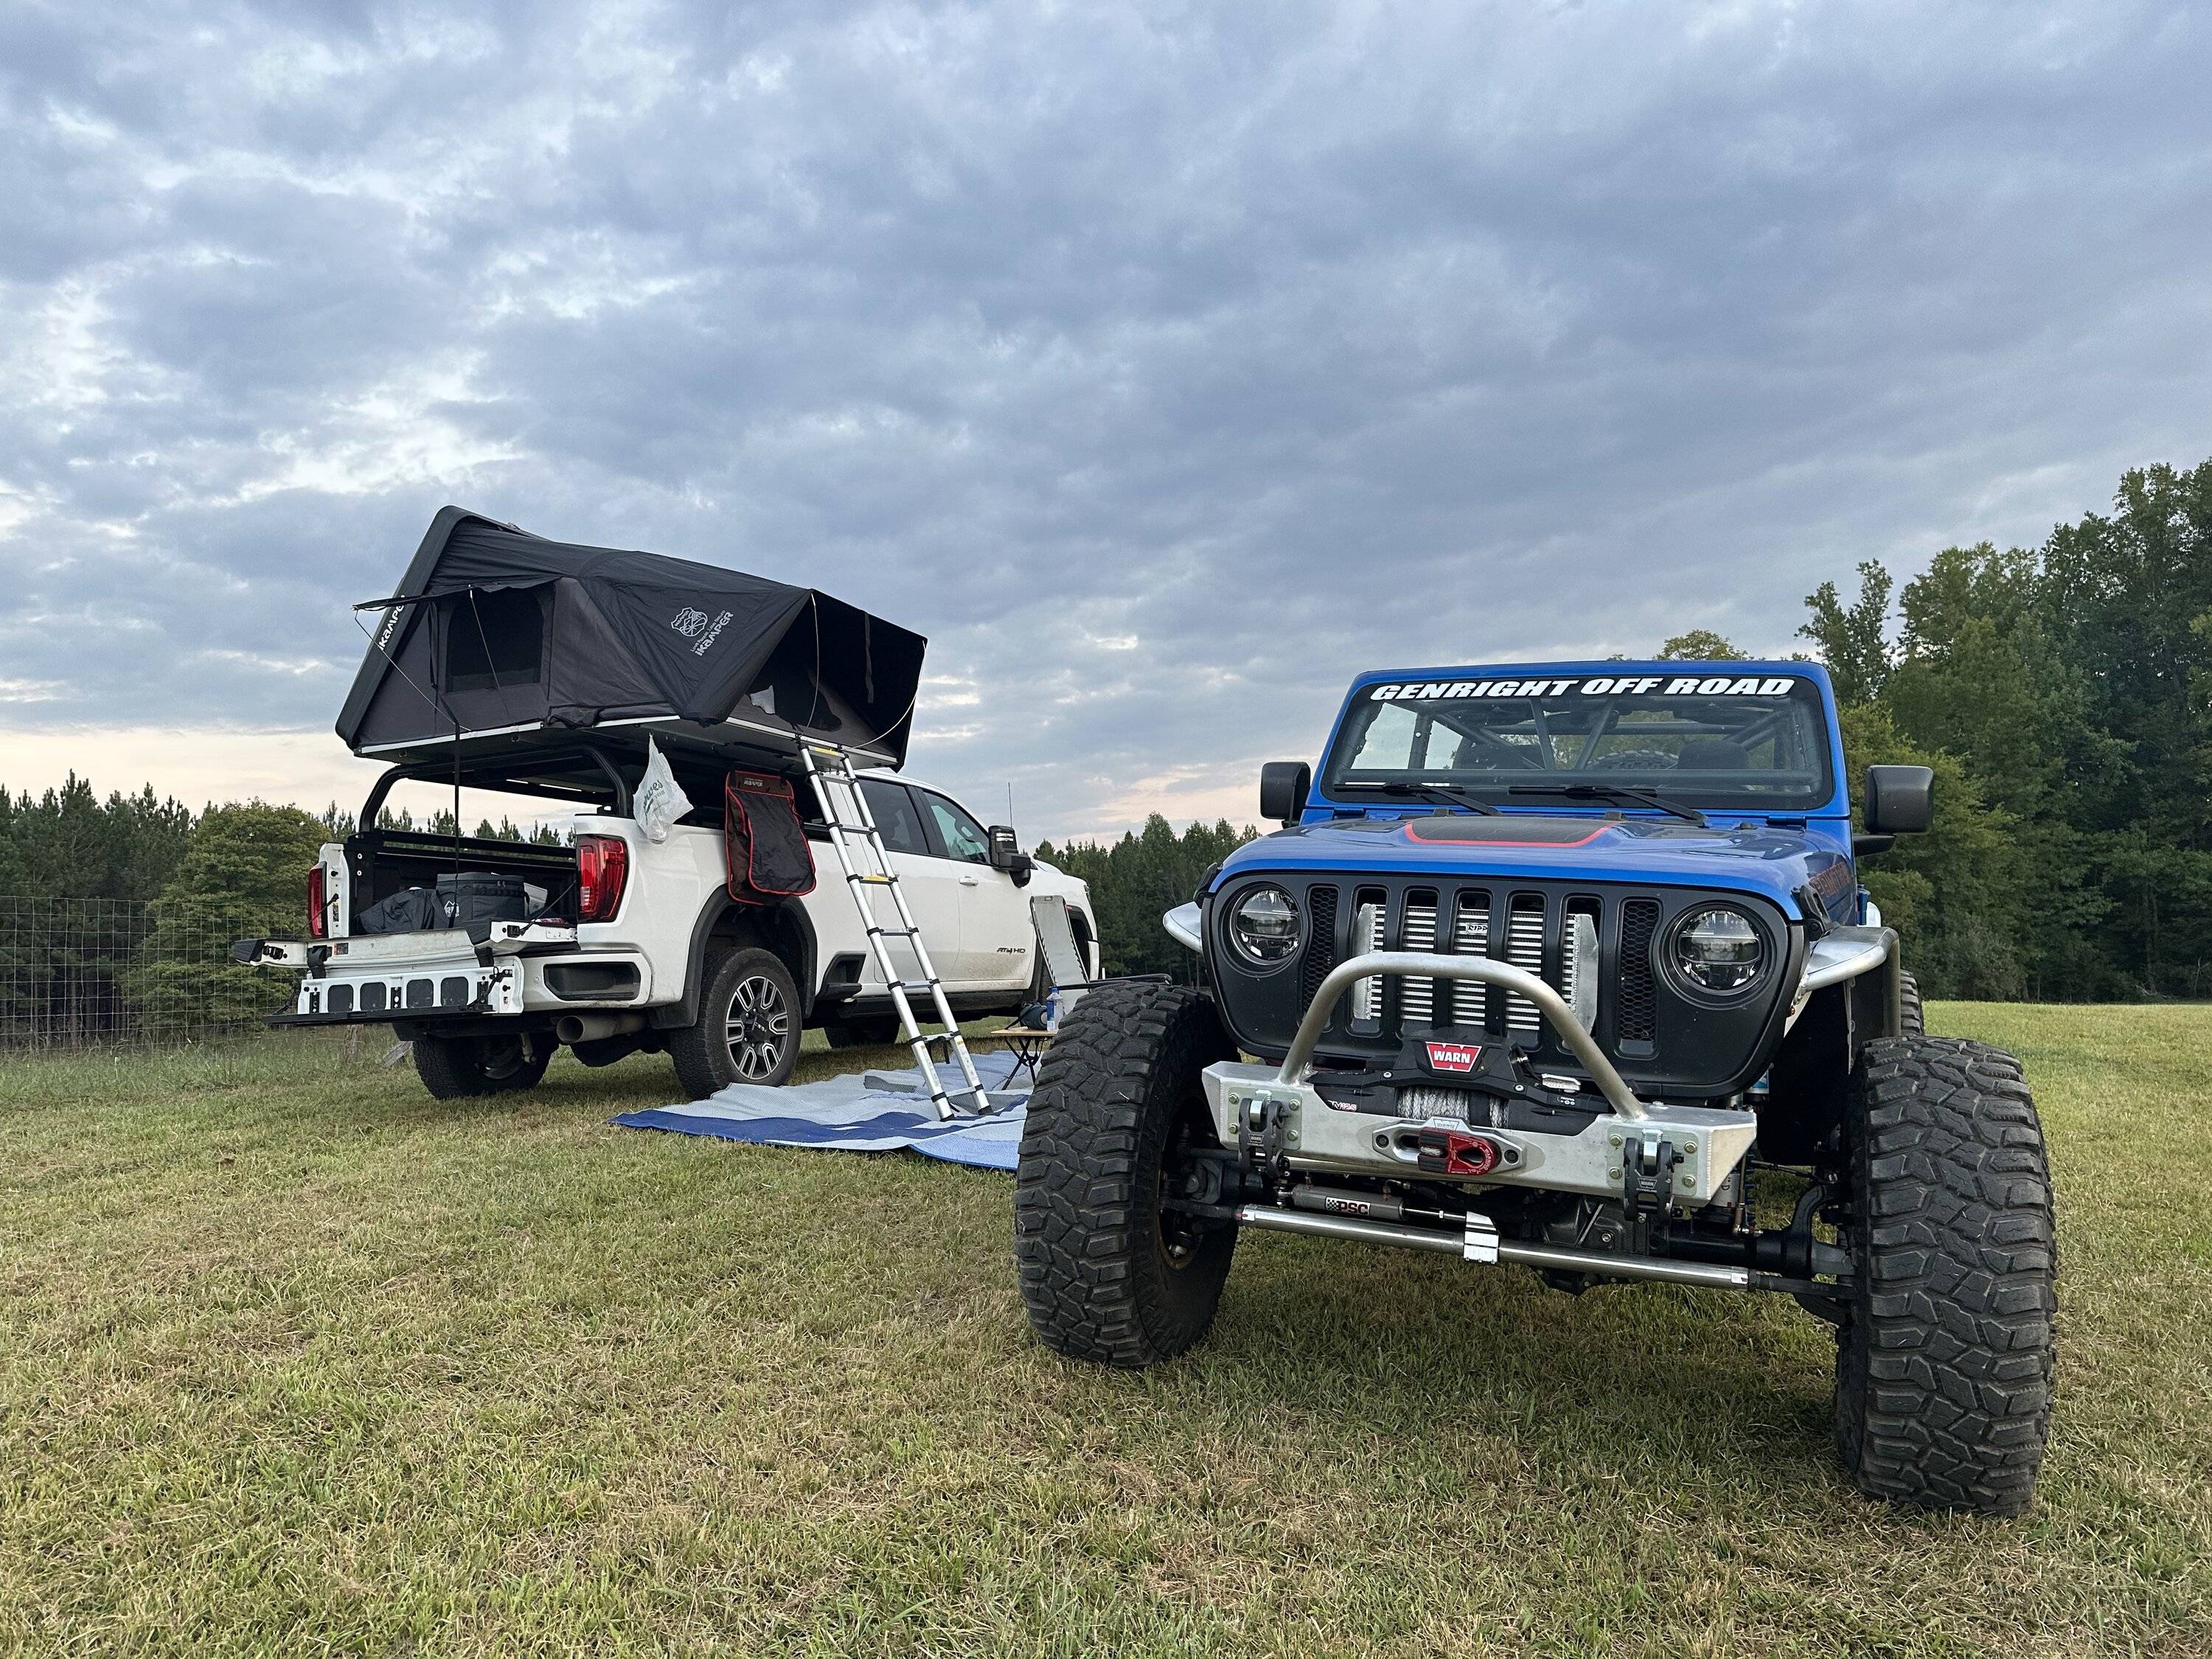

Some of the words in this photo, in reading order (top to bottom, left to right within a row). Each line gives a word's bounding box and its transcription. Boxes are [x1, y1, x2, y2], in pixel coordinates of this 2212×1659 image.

[378, 595, 406, 651] iKAMPE
[1370, 680, 1579, 700] GENRIGHT
[1580, 678, 1663, 695] OFF
[1663, 678, 1795, 695] ROAD
[1433, 1050, 1471, 1064] WARN
[1336, 1200, 1368, 1215] PSC
